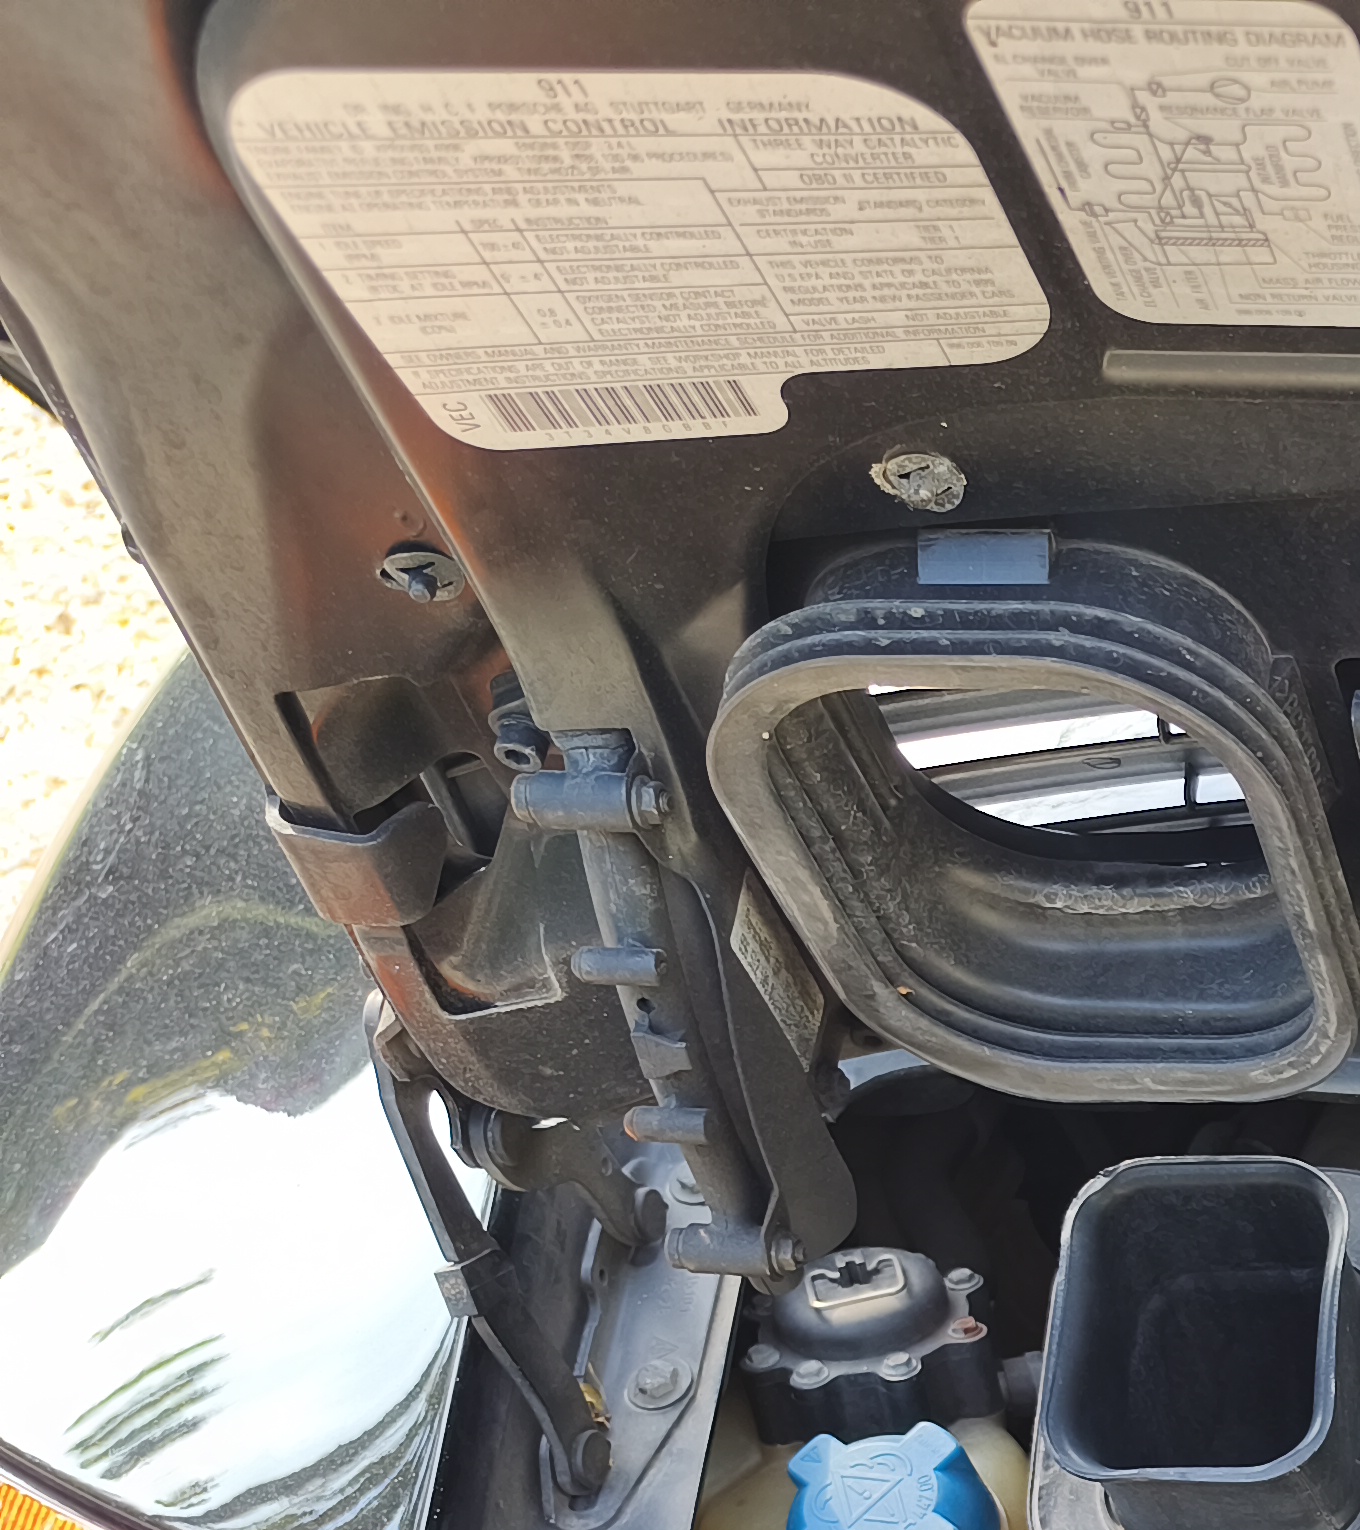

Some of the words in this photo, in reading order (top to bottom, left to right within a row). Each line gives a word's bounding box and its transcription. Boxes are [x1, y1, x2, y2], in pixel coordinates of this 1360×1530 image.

[1123, 0, 1174, 19] 911
[974, 24, 1075, 43] VACUUM
[1080, 28, 1137, 44] HOSE
[1144, 29, 1238, 47] ROUTING
[1245, 30, 1347, 48] DIAGRAM
[537, 78, 588, 99] 911
[256, 119, 372, 138] VEHICLE
[387, 118, 530, 137] EMISSION
[544, 117, 677, 136] CONTROL
[717, 115, 919, 134] INFORMATION
[752, 138, 808, 151] THREE
[814, 138, 856, 150] WAY
[863, 136, 960, 149] CATALYTIC
[810, 152, 915, 165] CONVERTER
[799, 173, 837, 186] OBD
[861, 171, 948, 184] CERTIFIED
[756, 226, 854, 239] CERTIFICATION
[789, 296, 833, 308] MODEL
[936, 309, 1011, 321] ADJUSTABLE
[736, 333, 799, 346] SCHEDULE
[830, 328, 901, 341] ADDITIONAL
[904, 325, 987, 337] INFORMATION
[746, 348, 799, 361] MANUAL
[831, 344, 886, 356] DETAILED
[691, 361, 762, 375] APPLICABLE
[809, 355, 870, 367] ALTITUDES
[442, 401, 482, 434] VEC
